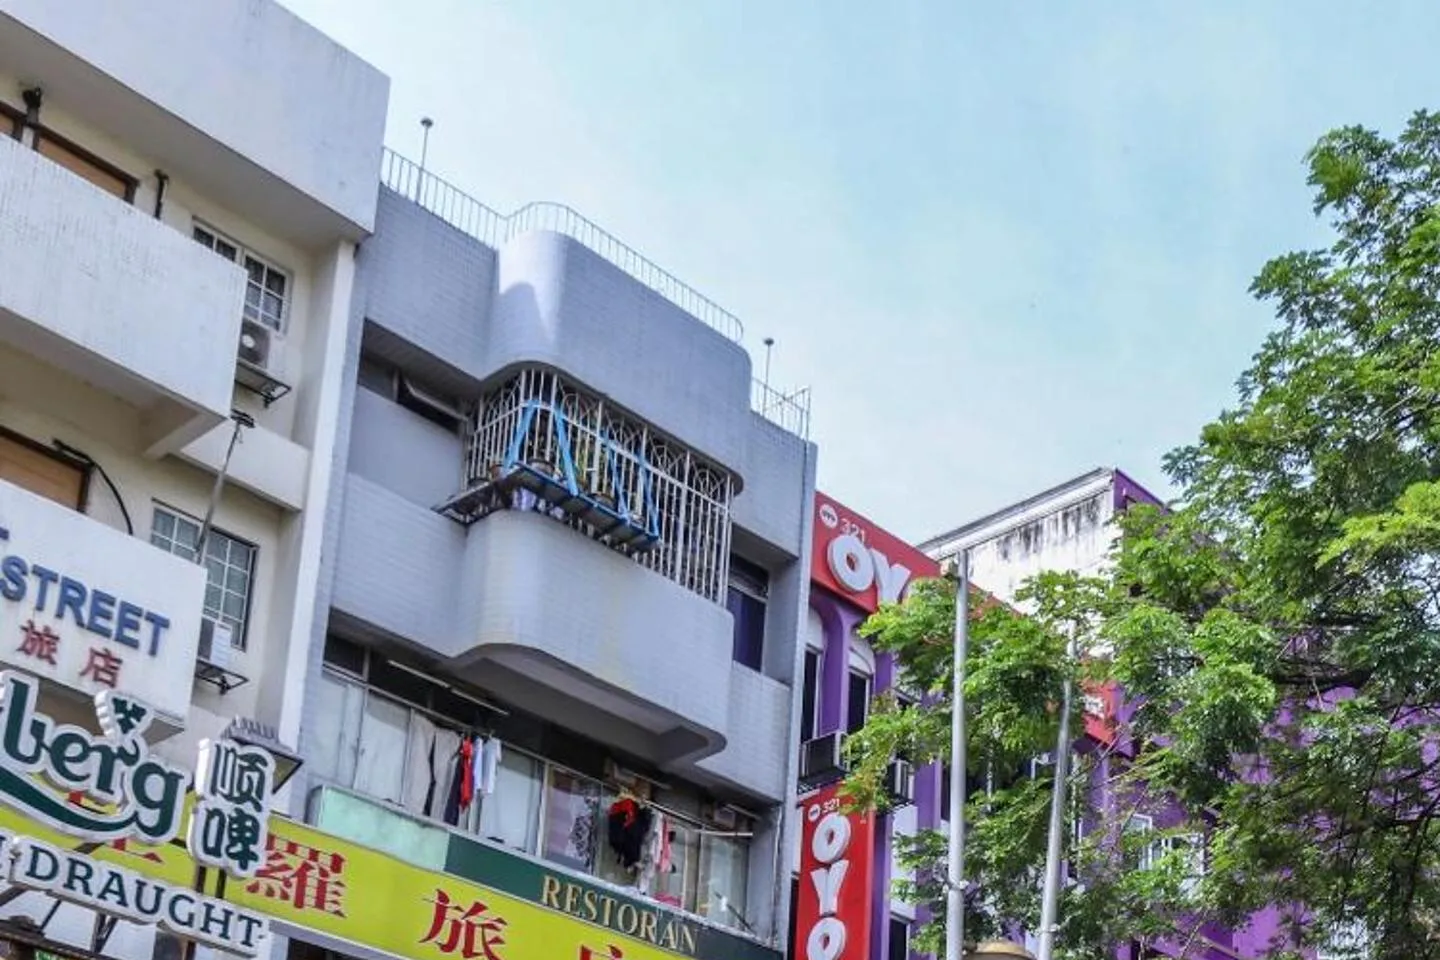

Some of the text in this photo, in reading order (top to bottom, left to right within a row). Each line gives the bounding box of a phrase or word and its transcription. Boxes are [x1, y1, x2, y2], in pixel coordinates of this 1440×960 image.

[0, 556, 170, 657] STREET
[827, 534, 912, 605] OY
[16, 619, 123, 688] 旅店
[0, 678, 185, 838] berg
[25, 845, 264, 949] DRAUGHT
[542, 875, 698, 954] RESTORAN
